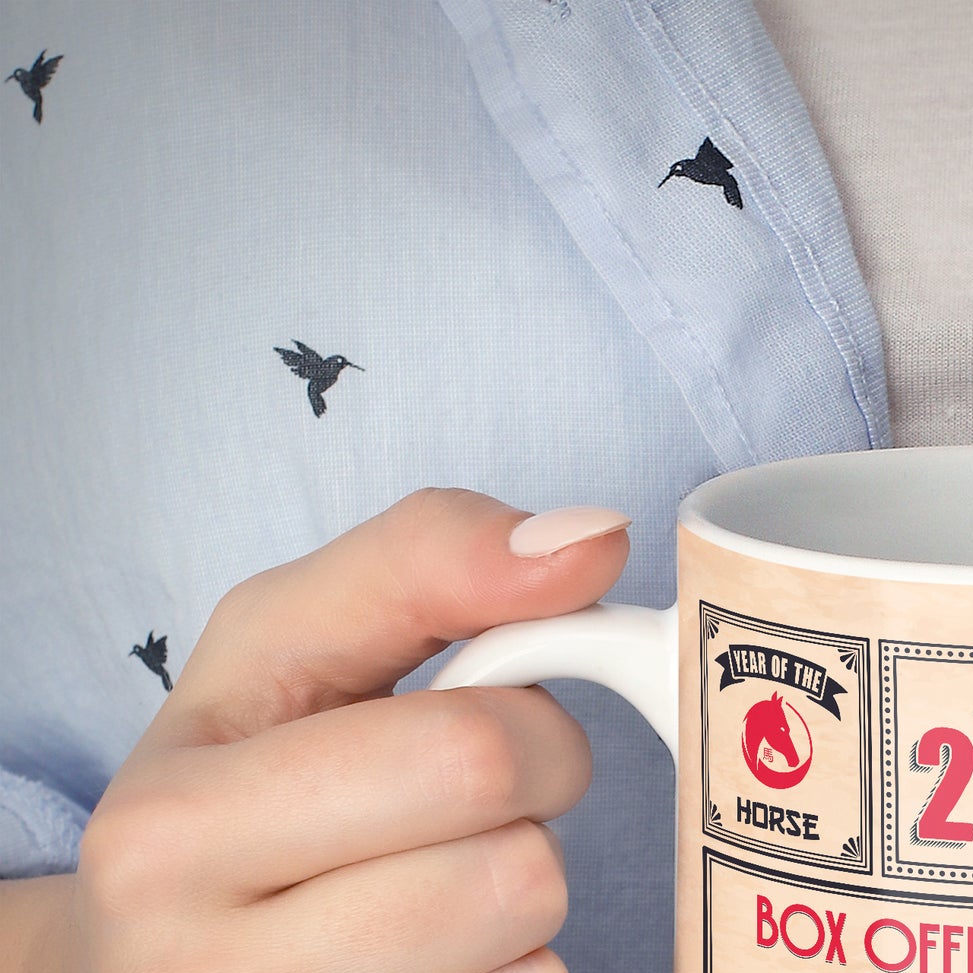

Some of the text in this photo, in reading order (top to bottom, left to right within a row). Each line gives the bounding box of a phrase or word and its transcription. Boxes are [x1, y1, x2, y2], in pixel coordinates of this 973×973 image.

[733, 650, 822, 693] YEAR OF THE
[736, 796, 820, 841] HORSE
[756, 894, 847, 966] BOX
